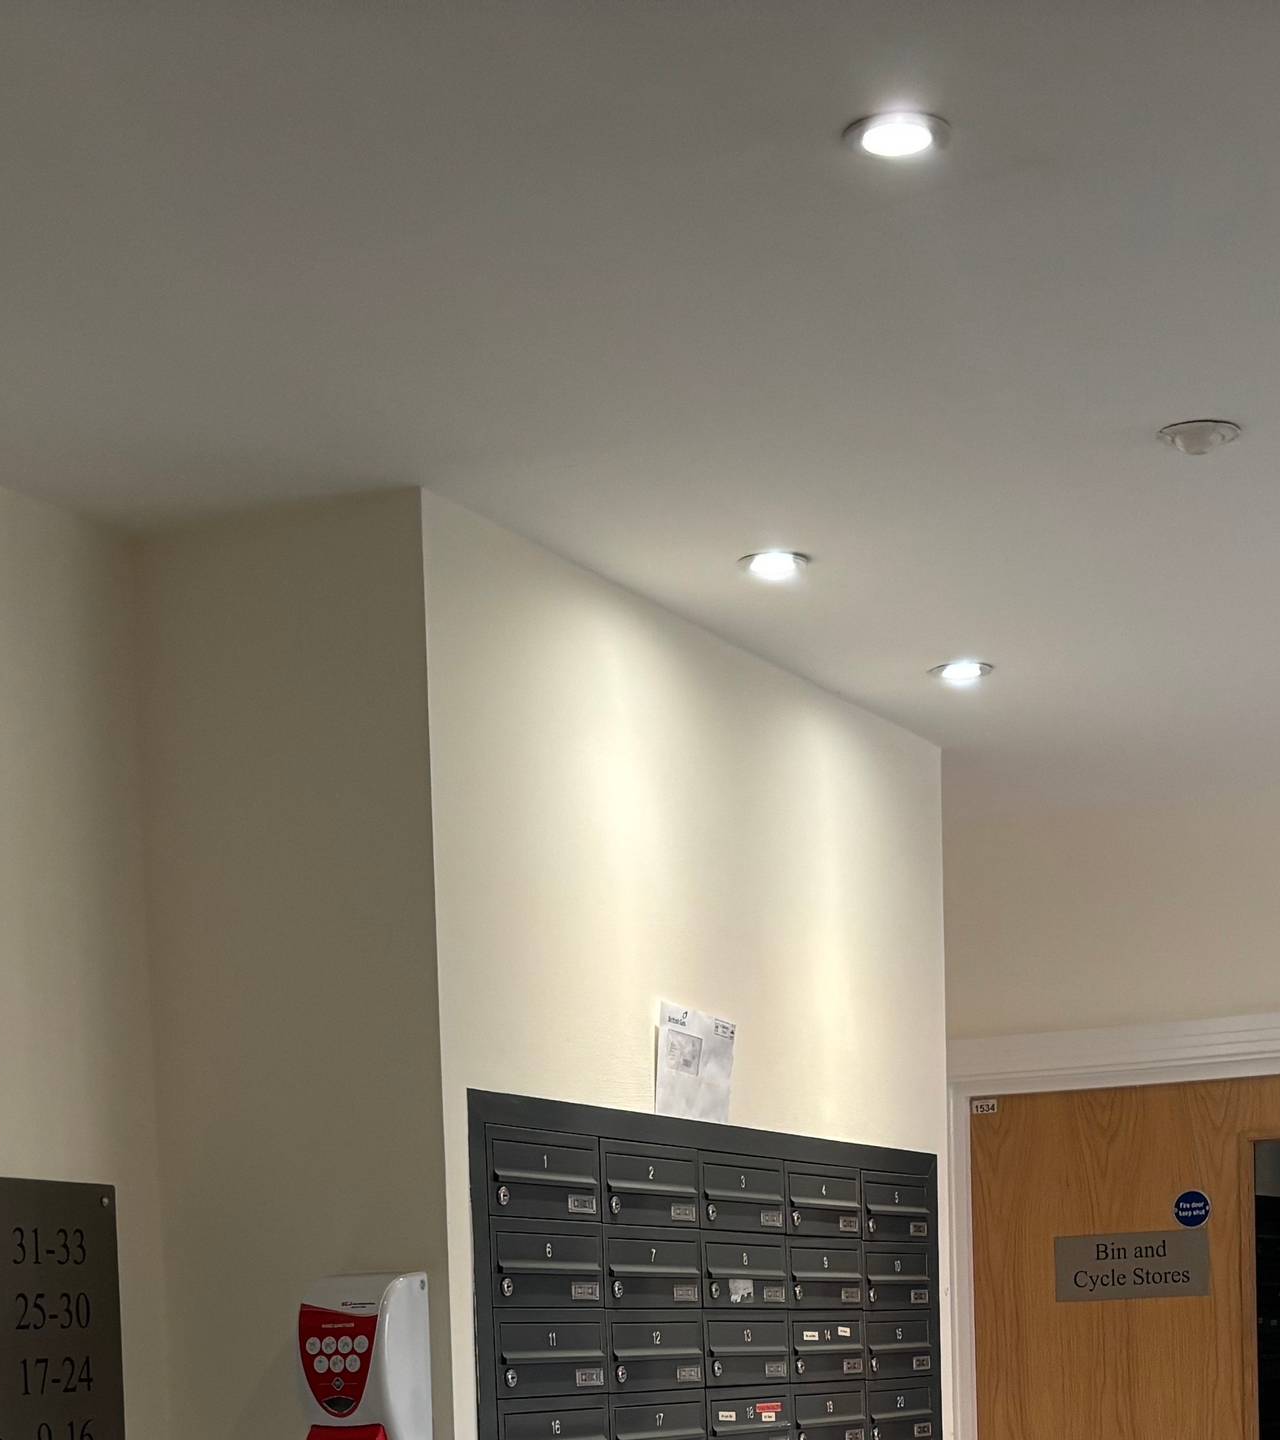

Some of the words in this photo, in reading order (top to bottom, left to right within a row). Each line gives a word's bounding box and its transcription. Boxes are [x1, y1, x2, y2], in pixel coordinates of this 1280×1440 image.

[975, 1103, 996, 1113] 1534
[12, 1227, 87, 1266] 31-33
[1095, 1241, 1128, 1261] Bin
[1133, 1239, 1168, 1259] and
[1073, 1268, 1127, 1292] Cycle
[1132, 1267, 1191, 1286] Stores
[15, 1292, 91, 1330] 25-30
[548, 1332, 557, 1346] 11
[652, 1331, 661, 1345] 12
[743, 1328, 752, 1342] 13
[824, 1329, 831, 1341] 14
[20, 1355, 94, 1396] 17-24
[655, 1412, 664, 1426] 17
[551, 1419, 561, 1434] 16
